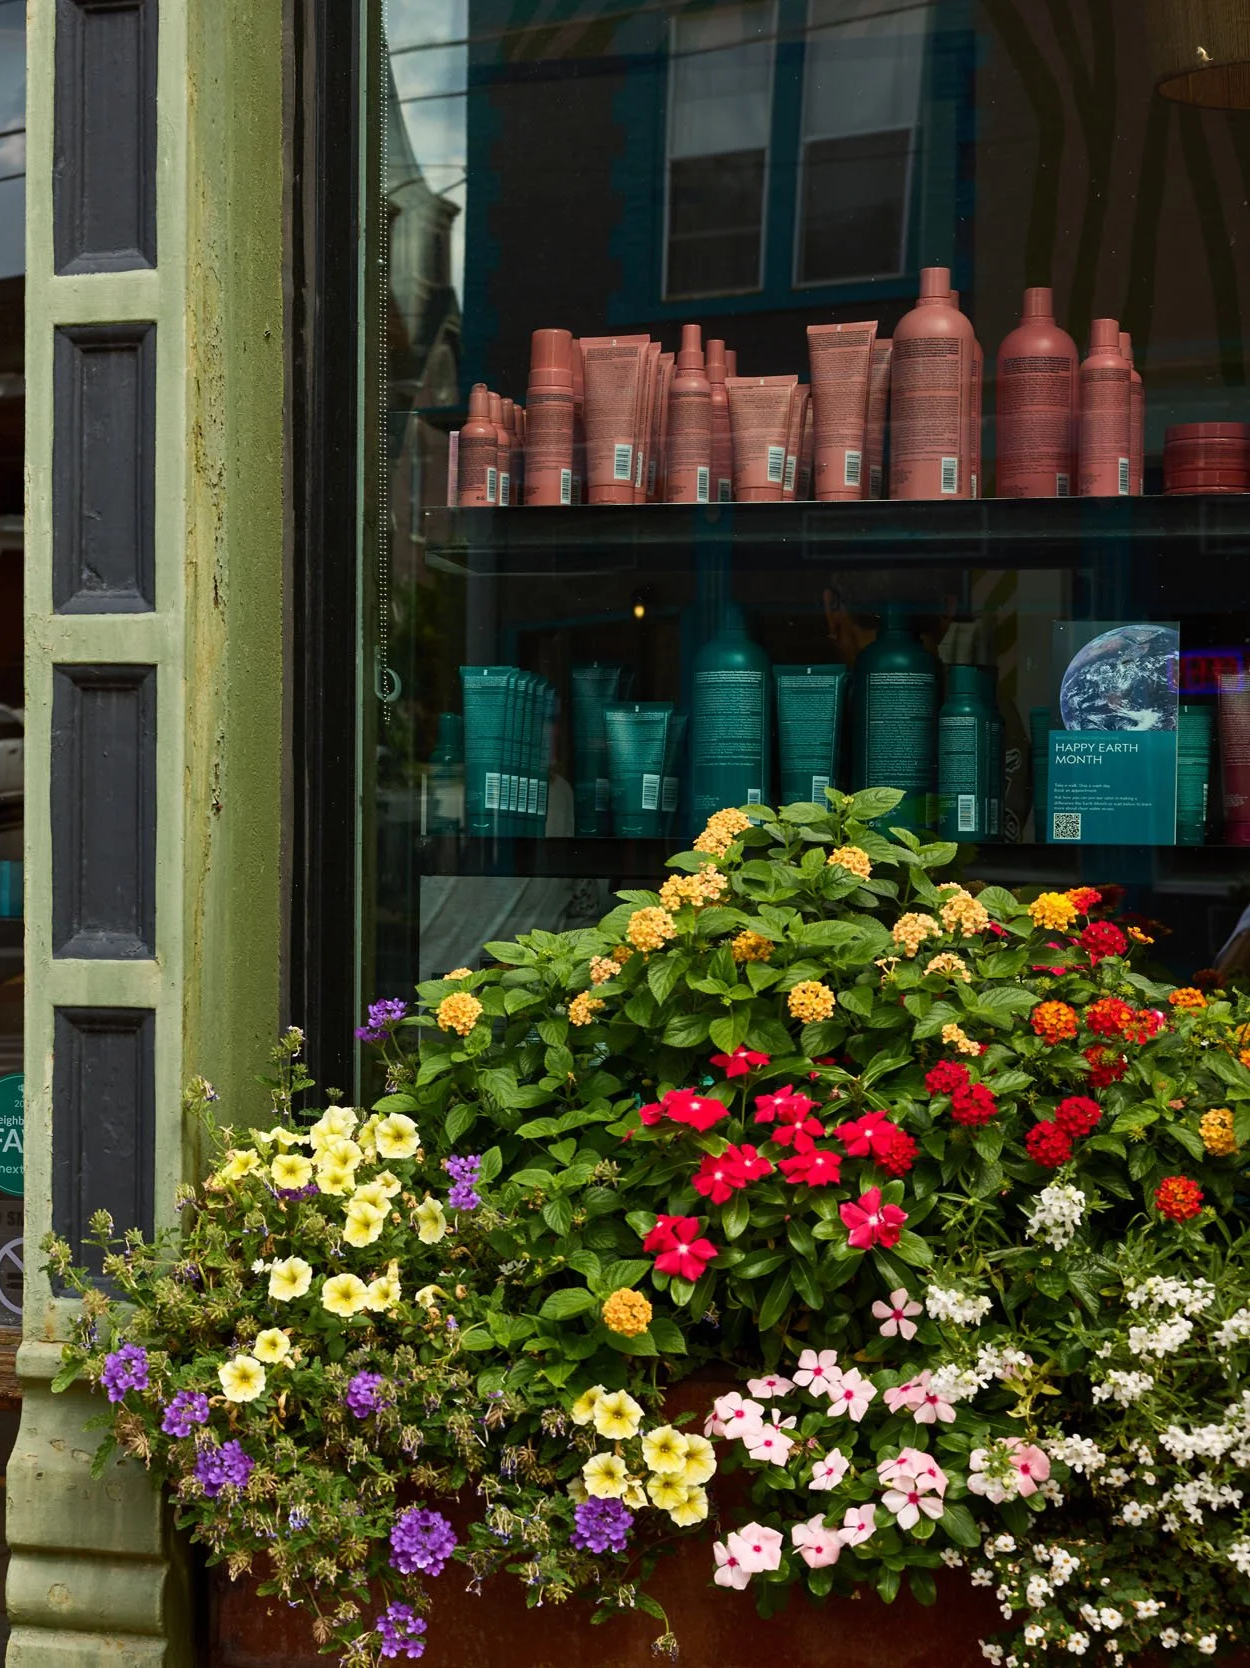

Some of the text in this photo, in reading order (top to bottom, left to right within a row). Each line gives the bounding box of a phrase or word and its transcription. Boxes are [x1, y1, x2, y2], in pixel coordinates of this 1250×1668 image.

[1055, 742, 1138, 753] HAPPY EARTH
[1055, 754, 1103, 765] MONTH
